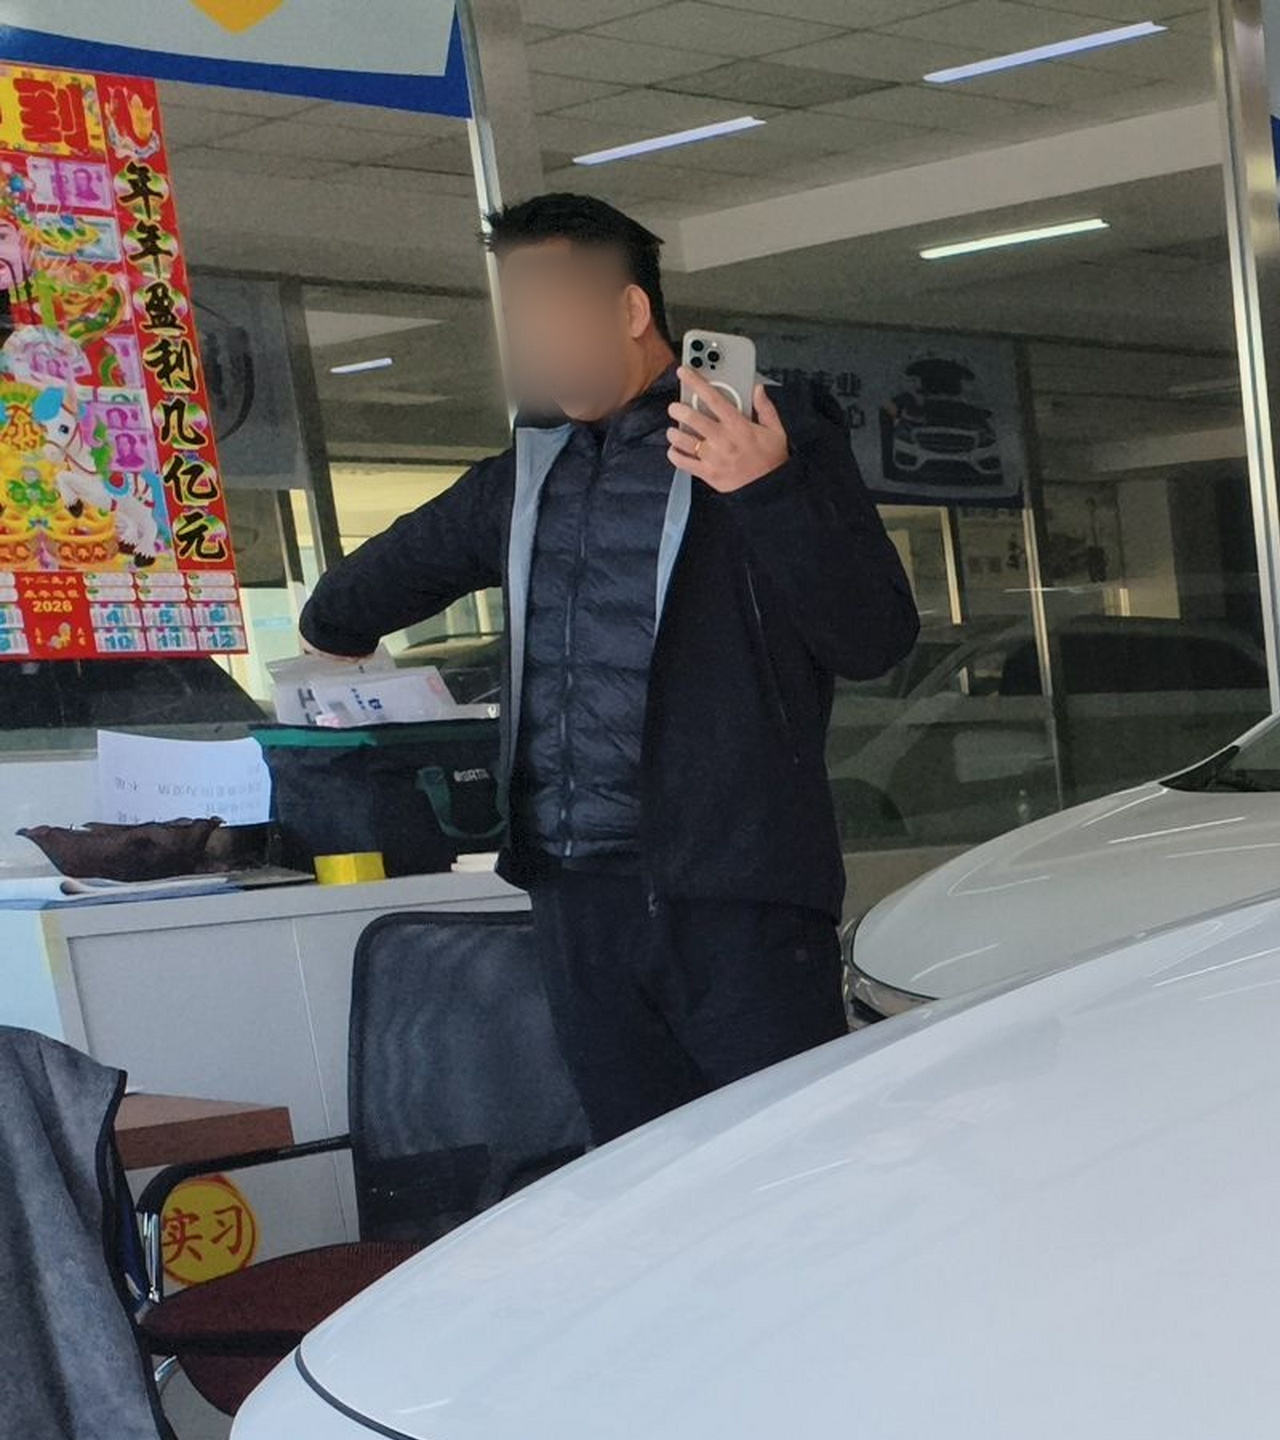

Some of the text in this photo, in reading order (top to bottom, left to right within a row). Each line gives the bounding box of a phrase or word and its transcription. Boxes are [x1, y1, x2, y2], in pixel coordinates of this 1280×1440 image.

[117, 160, 226, 559] 年年盈利几亿元
[32, 600, 73, 613] 2026
[105, 635, 133, 650] 10
[158, 634, 181, 648] 11
[209, 634, 237, 649] 12
[162, 1205, 243, 1264] 实习
